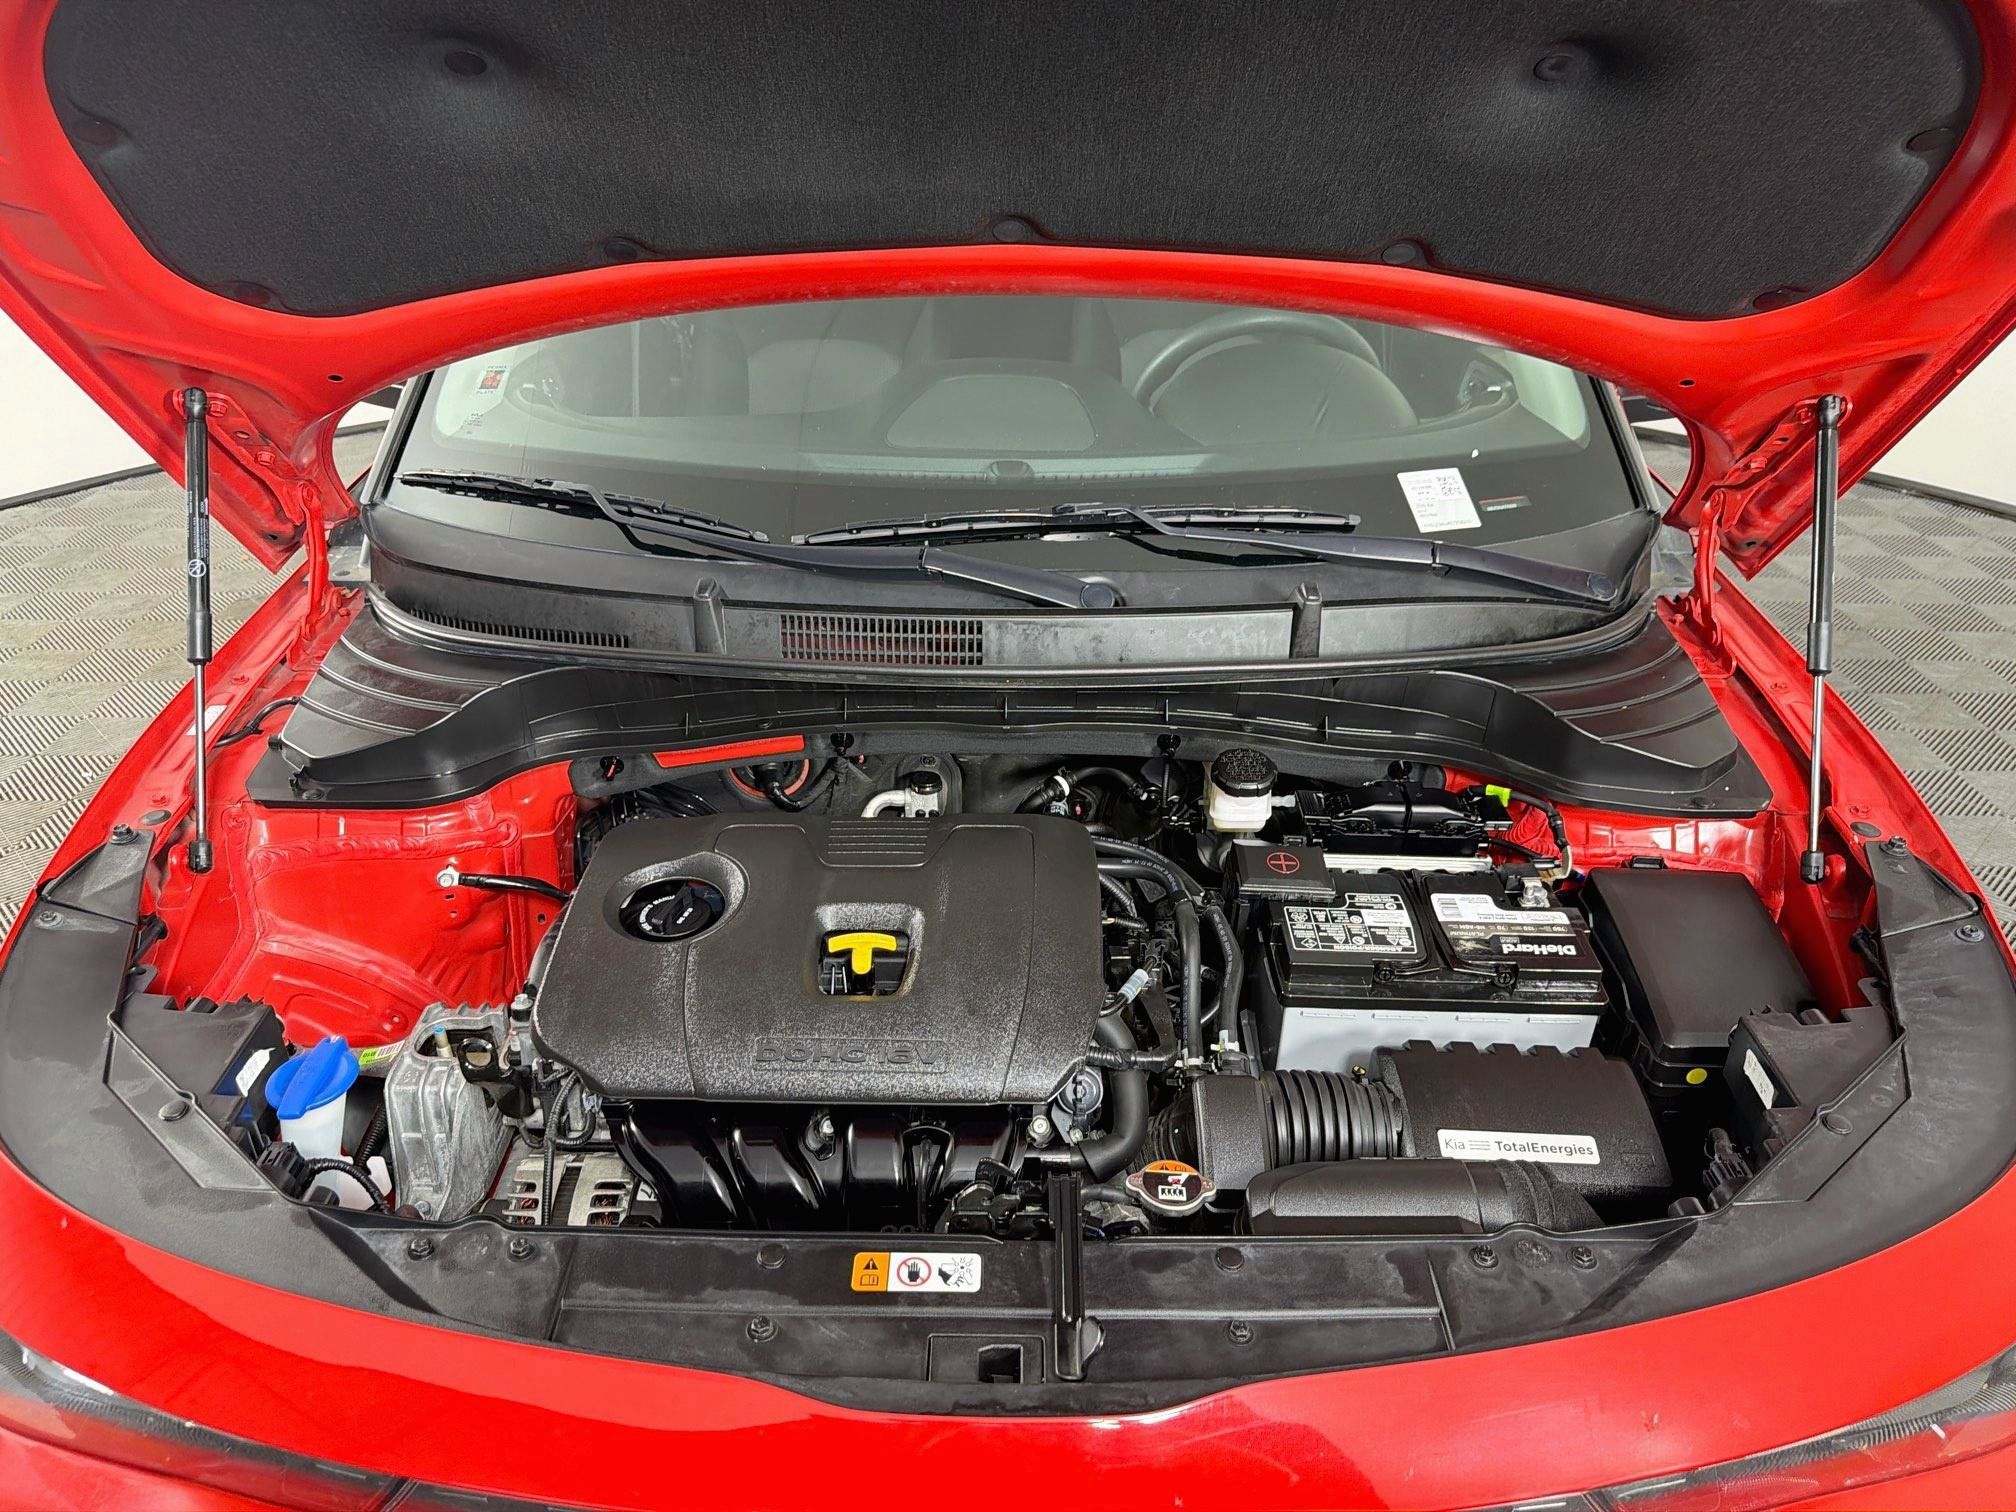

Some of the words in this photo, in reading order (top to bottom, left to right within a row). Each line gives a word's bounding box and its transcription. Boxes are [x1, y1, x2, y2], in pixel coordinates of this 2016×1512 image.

[1501, 943, 1577, 956] DieHard
[756, 1041, 867, 1063] DOHC
[1444, 1138, 1466, 1151] Kia
[1494, 1141, 1594, 1156] TotalEnergies
